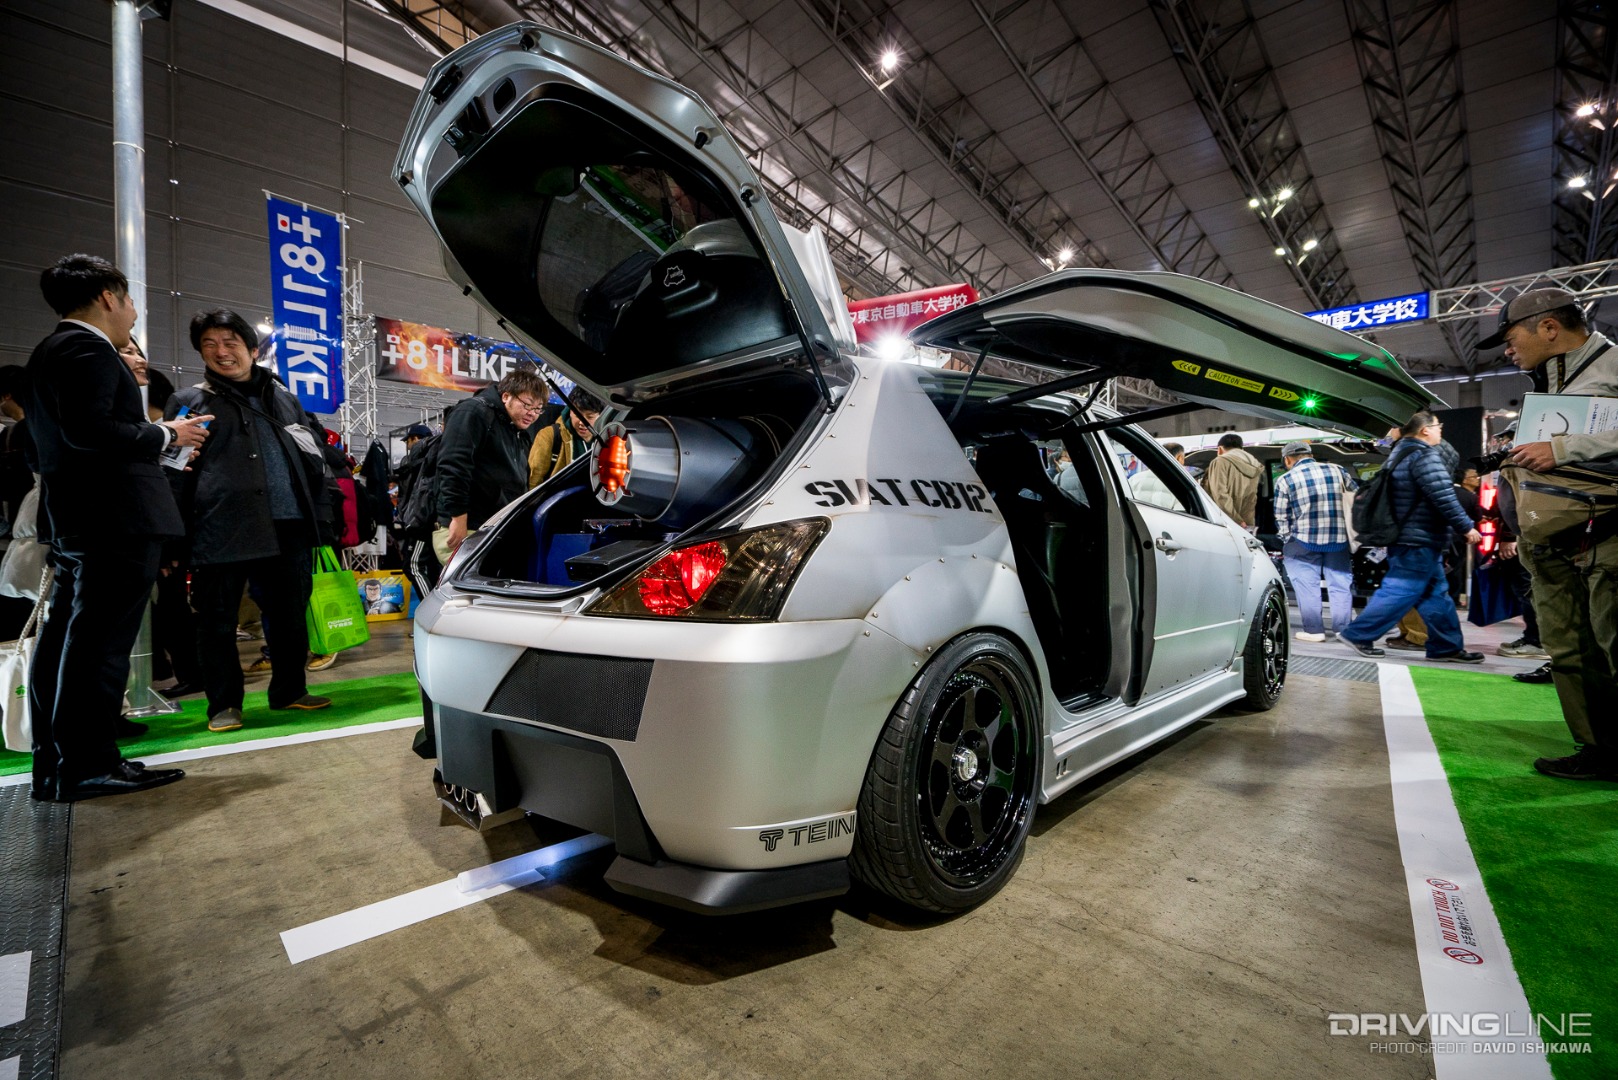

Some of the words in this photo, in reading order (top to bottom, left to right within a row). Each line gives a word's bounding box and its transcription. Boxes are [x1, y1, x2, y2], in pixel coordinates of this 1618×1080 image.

[1208, 370, 1240, 385] CAUTION
[910, 479, 993, 513] CB12
[788, 814, 855, 846] TEIN
[1437, 913, 1456, 931] NOT
